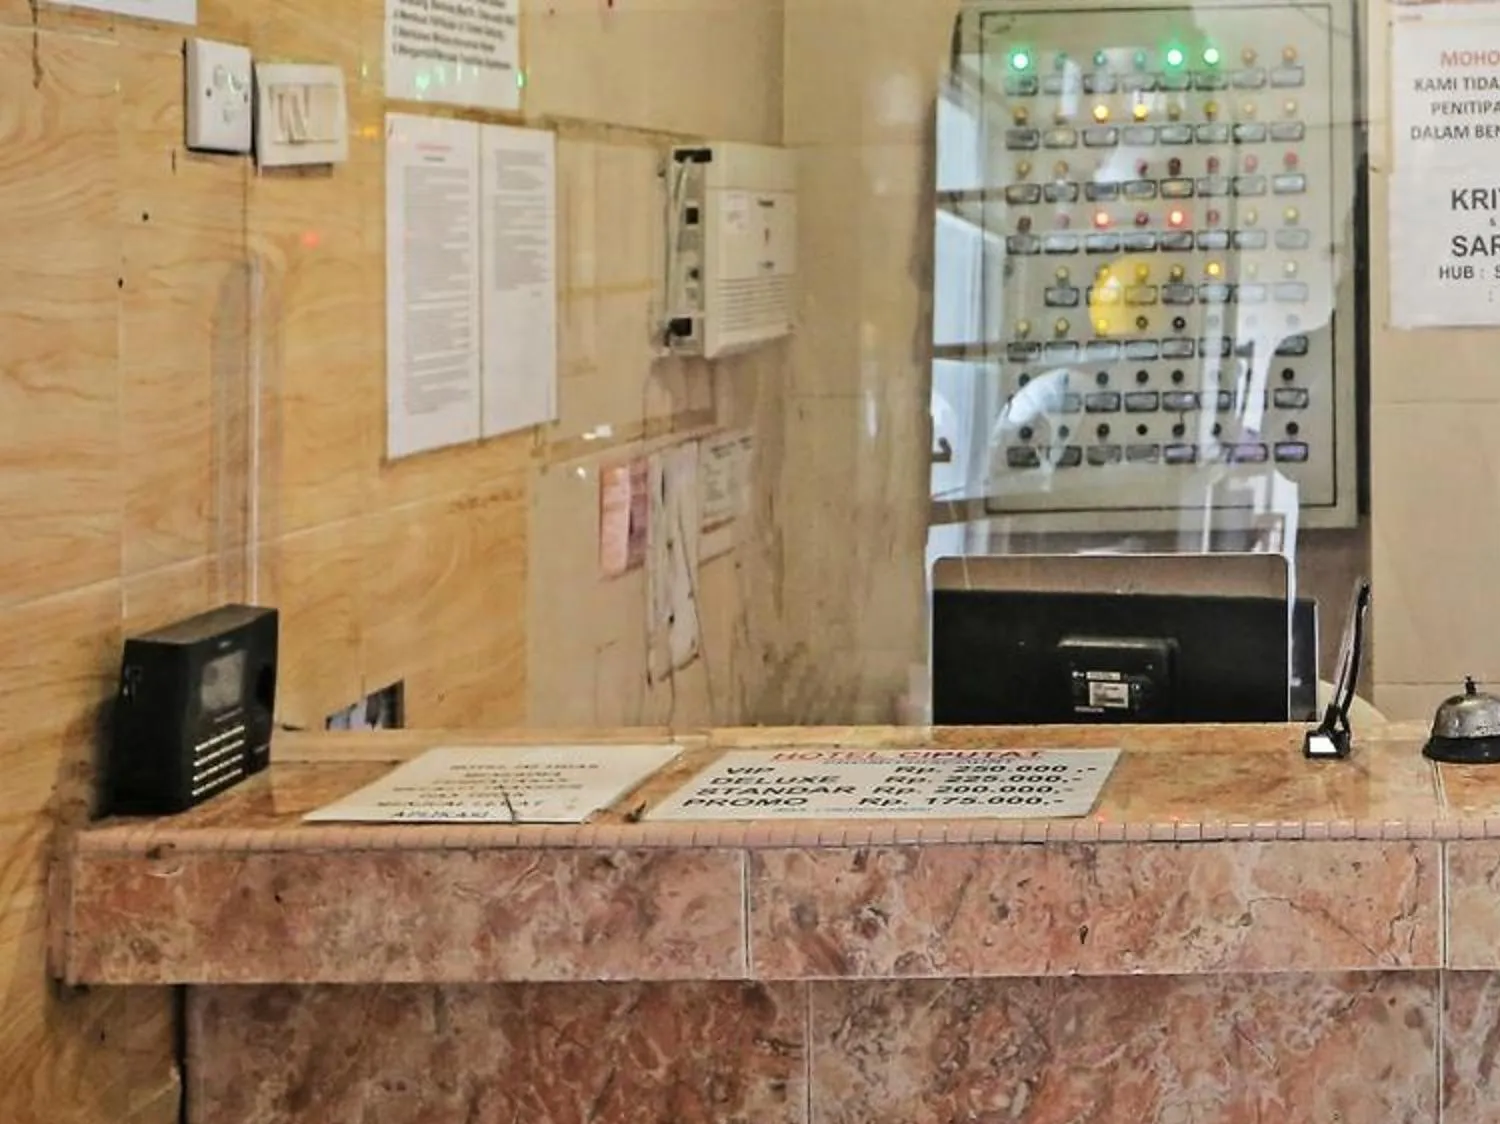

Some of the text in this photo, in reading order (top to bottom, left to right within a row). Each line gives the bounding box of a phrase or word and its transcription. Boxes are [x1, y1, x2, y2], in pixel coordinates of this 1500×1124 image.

[1414, 76, 1457, 92] KAMI
[1410, 124, 1470, 141] DALAM
[1439, 265, 1475, 280] HUB
[771, 751, 878, 761] HOTEL
[725, 767, 777, 775] VIP
[894, 765, 942, 775] Rp.
[710, 775, 840, 785] DELUXE
[884, 775, 934, 785] Rp.
[696, 785, 857, 796] STANDAR
[872, 785, 922, 796] Rp.
[682, 796, 809, 807] PROMO
[858, 796, 909, 807] Rp.
